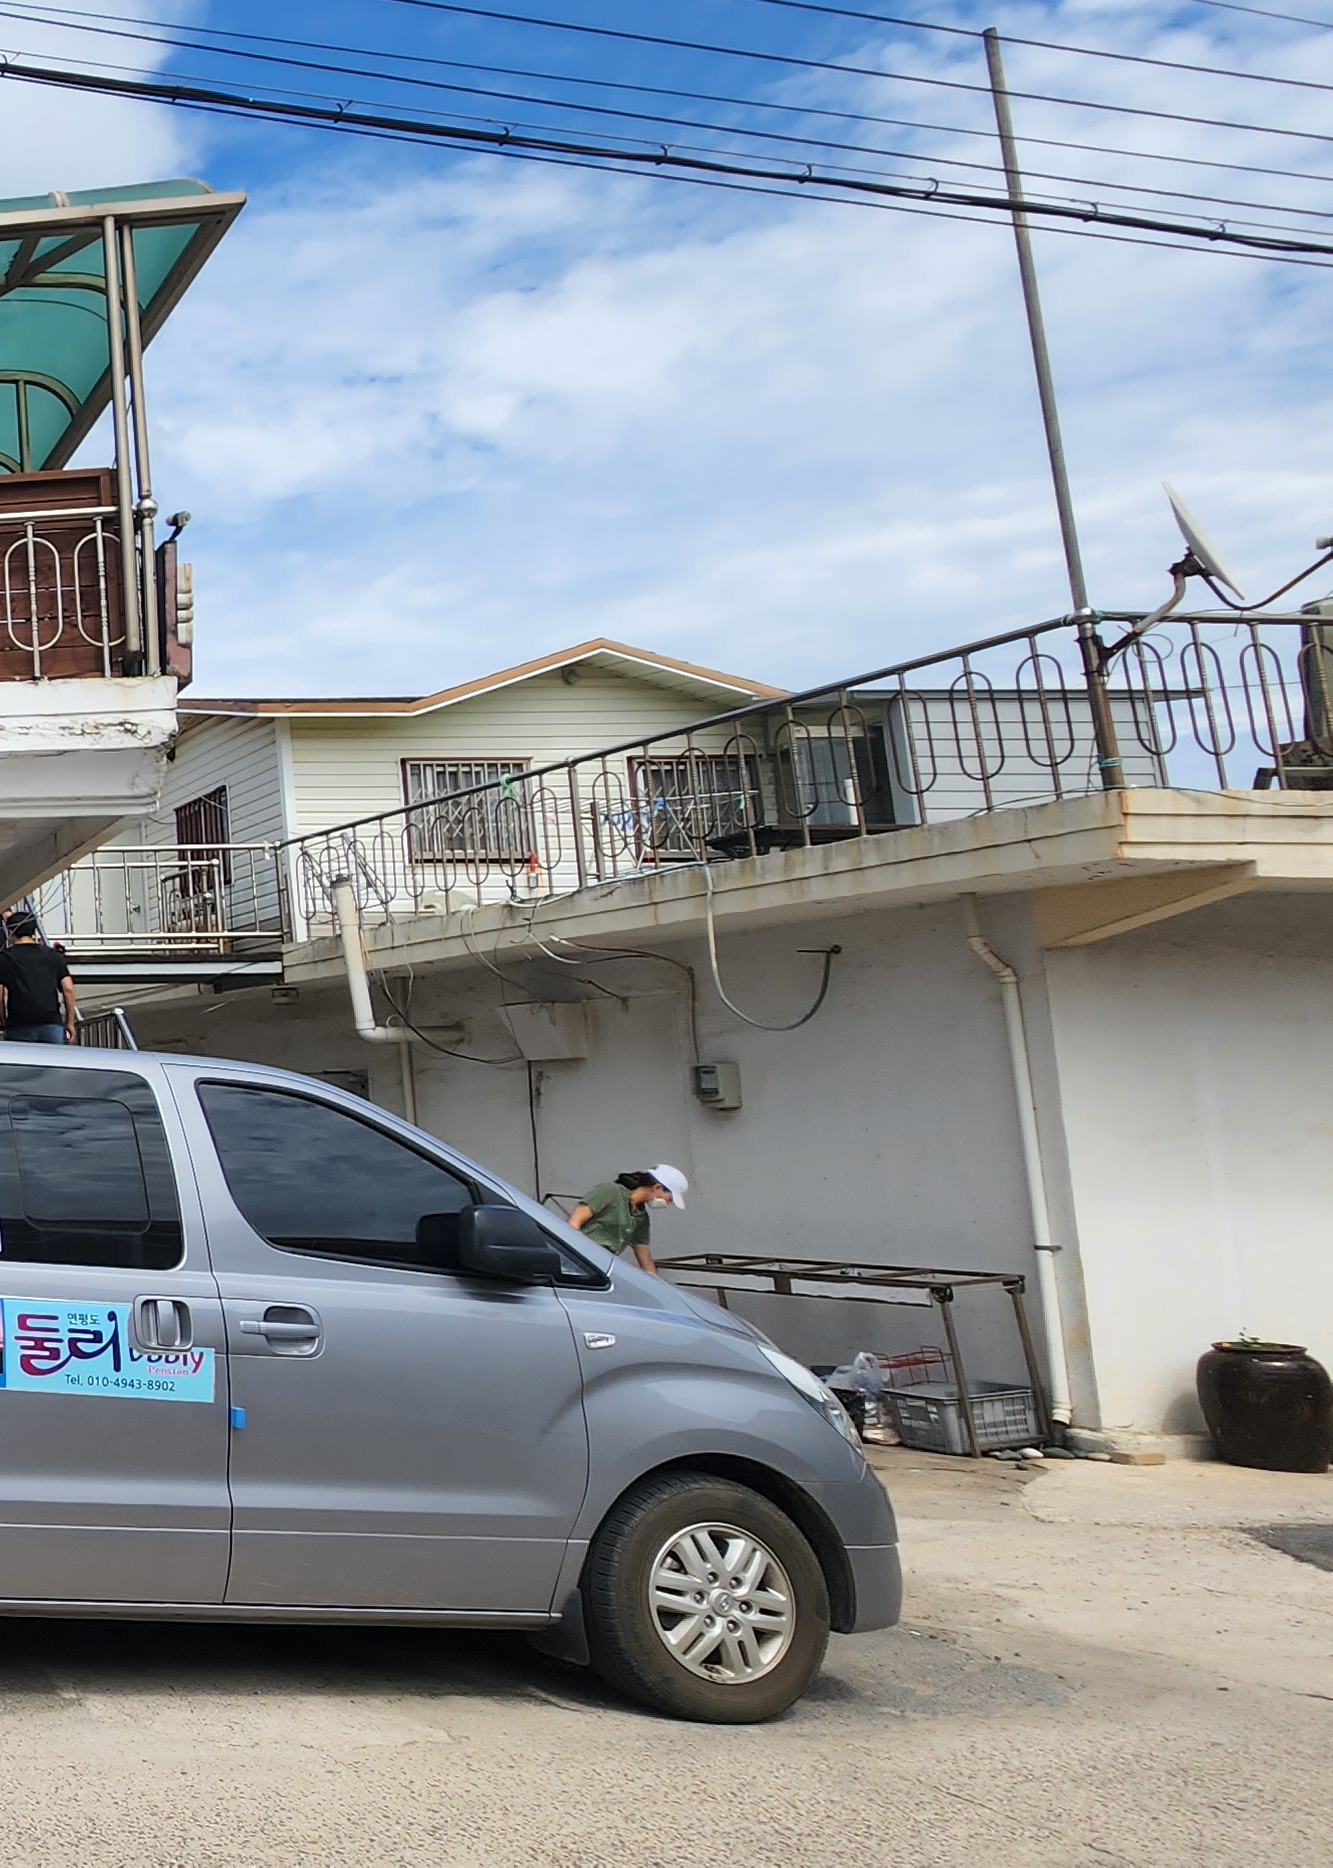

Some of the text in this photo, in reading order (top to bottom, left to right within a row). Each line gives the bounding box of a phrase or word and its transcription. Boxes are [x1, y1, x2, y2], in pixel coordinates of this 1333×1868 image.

[67, 1312, 101, 1326] 연평도
[64, 1374, 176, 1392] Tel. 010-4943-8902
